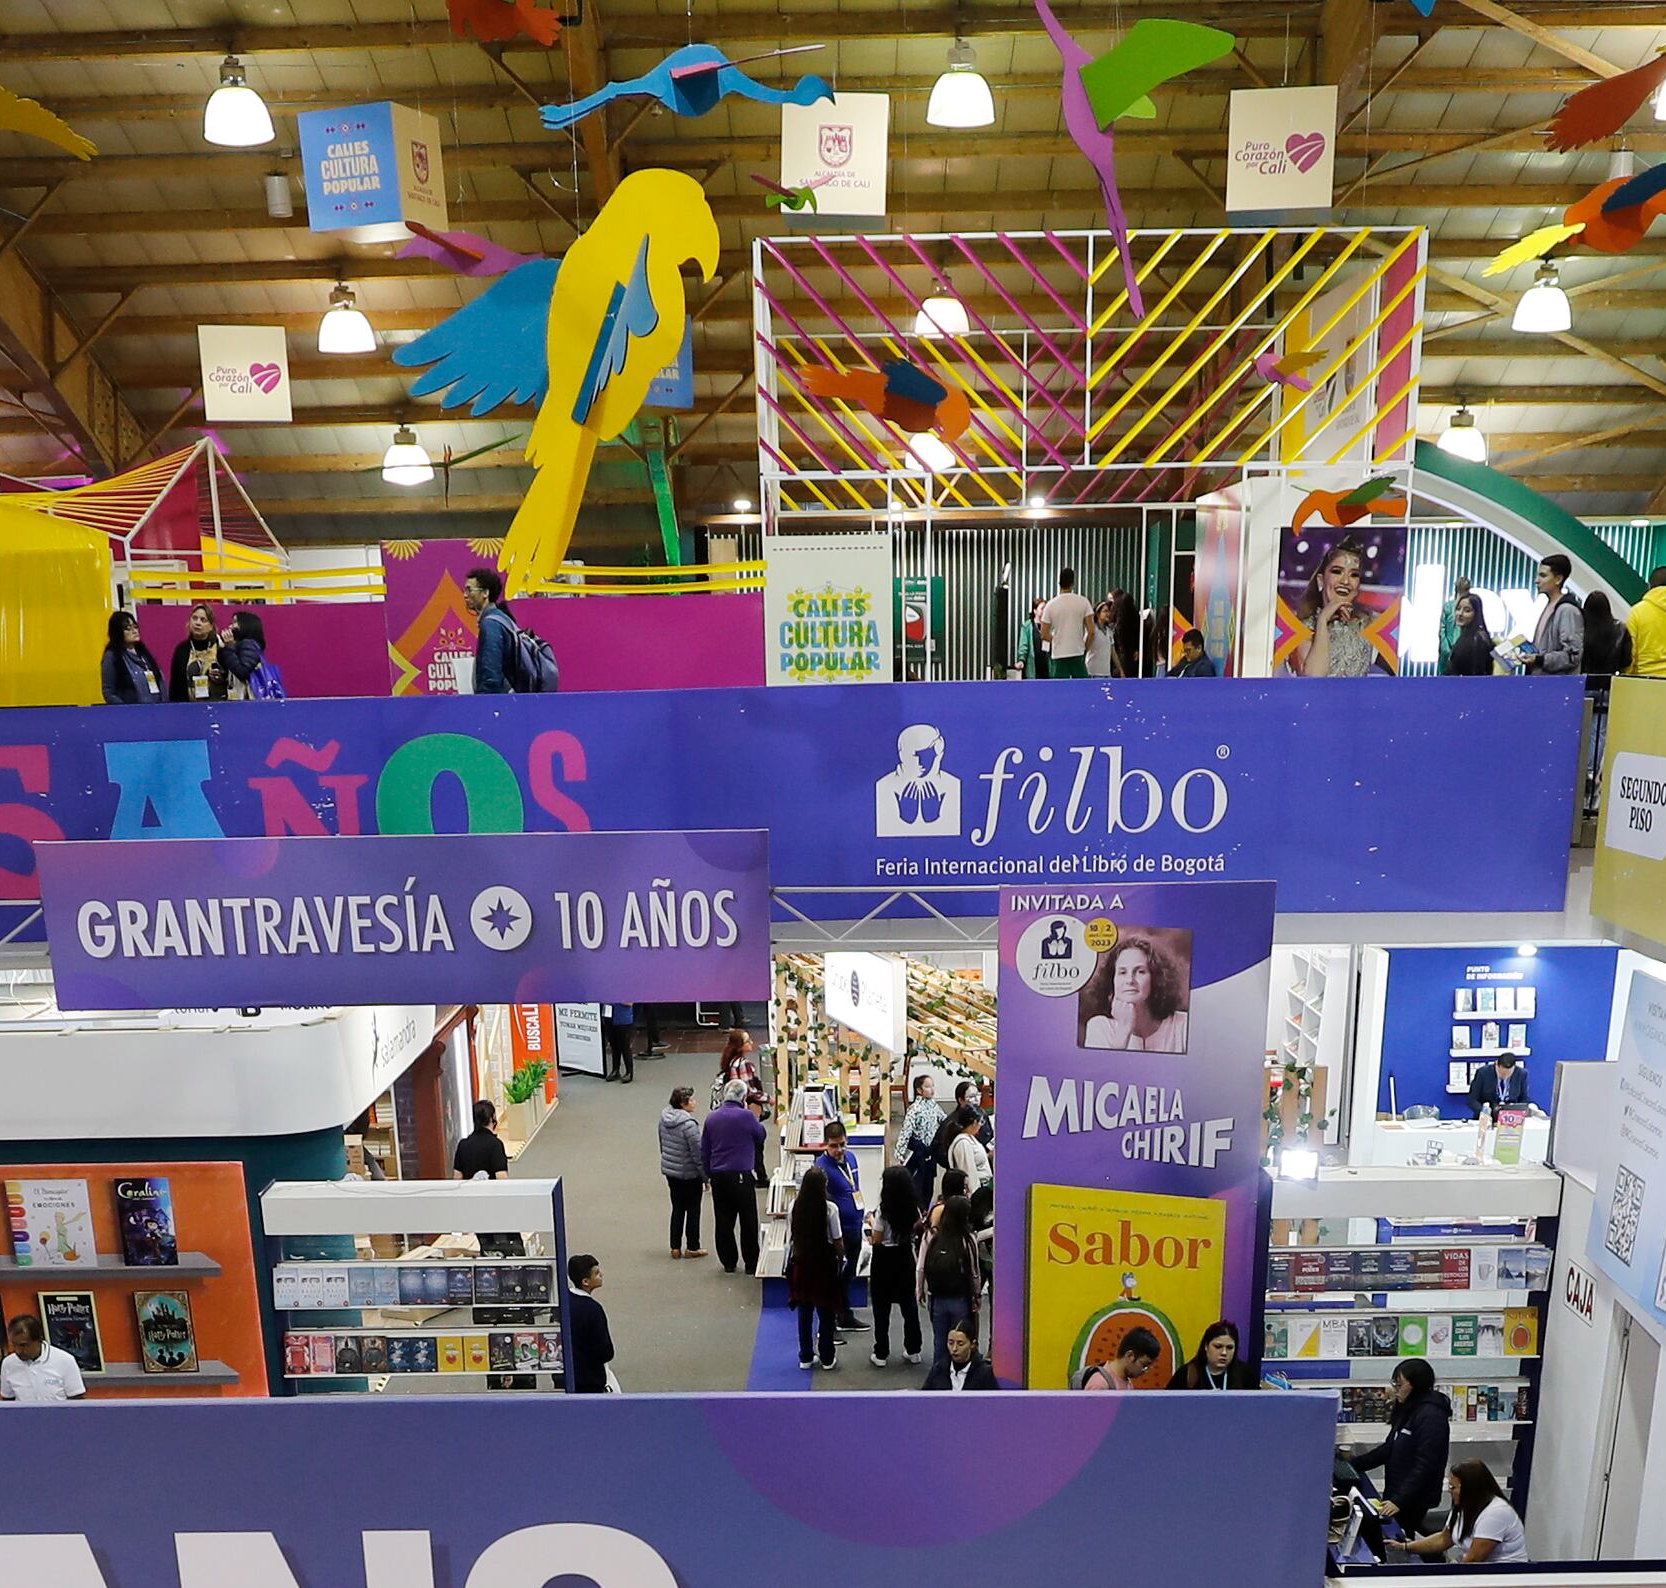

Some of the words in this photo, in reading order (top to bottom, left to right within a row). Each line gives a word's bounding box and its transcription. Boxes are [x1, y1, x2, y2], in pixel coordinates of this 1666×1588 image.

[327, 141, 352, 158] CALI
[353, 140, 369, 155] ES
[1234, 146, 1285, 163] Corazón
[1244, 141, 1271, 153] Puro
[321, 155, 379, 180] CULTURA
[1259, 158, 1288, 175] Cali
[323, 176, 381, 195] POPULAR
[207, 371, 252, 384] Corazón
[214, 366, 237, 376] Puro
[230, 379, 254, 395] Cali
[779, 619, 880, 650] CULTURA
[779, 650, 881, 672] POPULAR
[967, 744, 1230, 848] filbo
[1628, 805, 1653, 834] PISO
[875, 855, 920, 877] Feria
[920, 853, 1044, 877] Internacional
[1046, 853, 1076, 877] del
[1081, 853, 1128, 876] Libro
[1131, 853, 1156, 875] de
[1159, 853, 1226, 878] Bogotá
[1011, 894, 1105, 911] INVITADA
[1109, 894, 1124, 910] A
[75, 875, 455, 959] GRANTRAVESÍA
[553, 889, 606, 952] 10
[619, 877, 739, 952] AÑOS
[1032, 962, 1080, 980] filbo
[1021, 1074, 1184, 1140] MICAELA
[1121, 1117, 1235, 1169] CHIRIF
[1046, 1218, 1213, 1271] Sabor
[1564, 1266, 1595, 1322] CAJA
[47, 1302, 66, 1316] Harry
[67, 1301, 91, 1315] Potter
